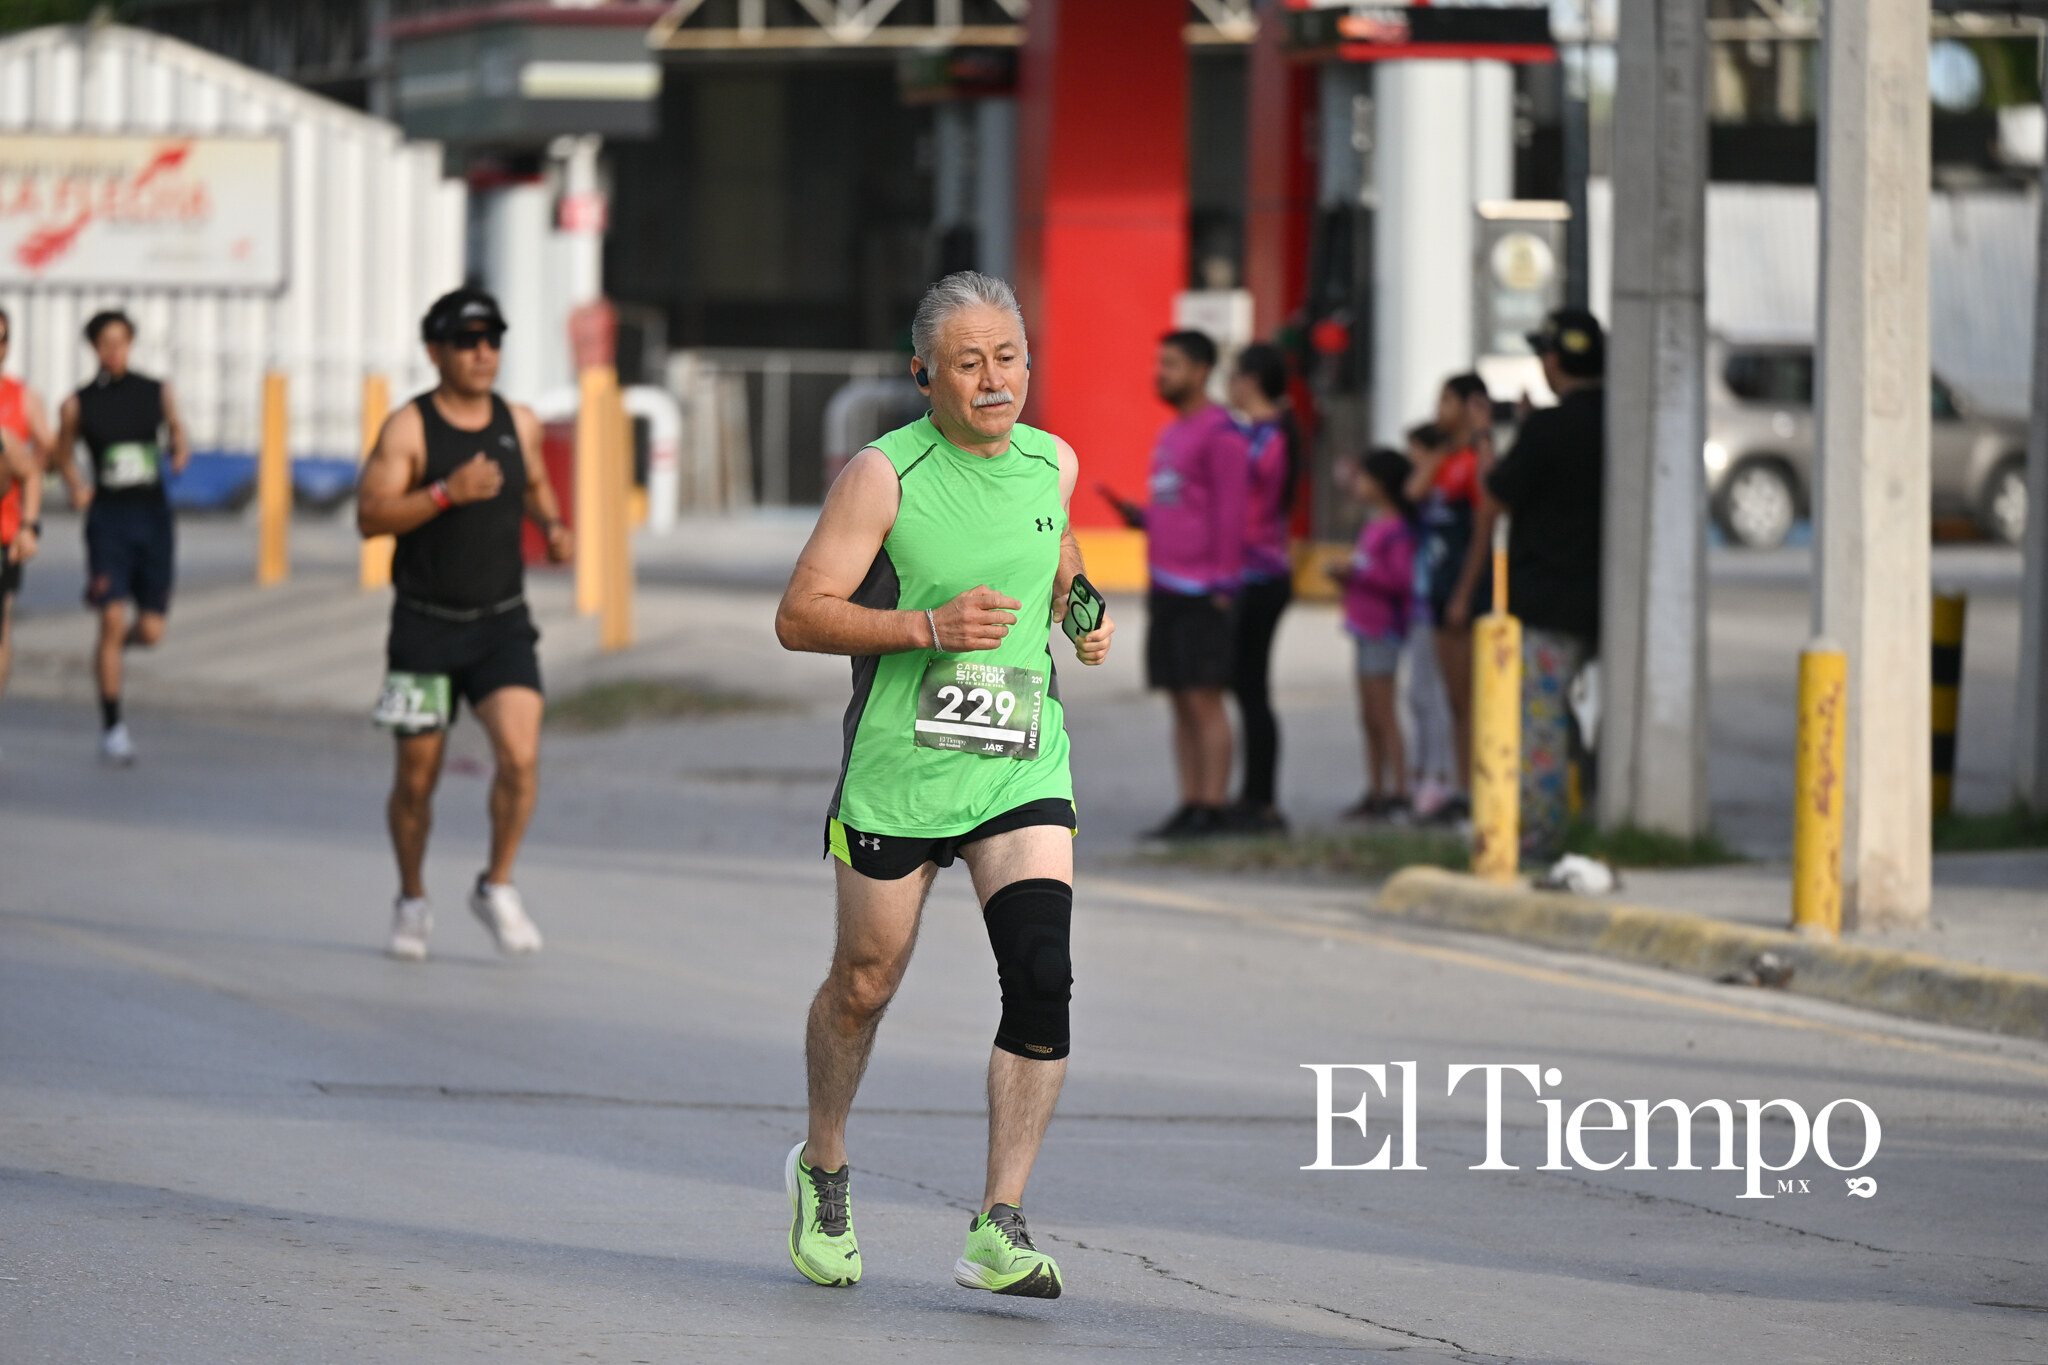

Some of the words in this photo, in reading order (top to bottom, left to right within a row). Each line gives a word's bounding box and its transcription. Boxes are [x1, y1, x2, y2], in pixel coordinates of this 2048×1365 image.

[956, 663, 1005, 674] CARRERA
[1031, 675, 1043, 685] 229
[934, 685, 1016, 727] 229
[1028, 690, 1041, 750] MEDALLA
